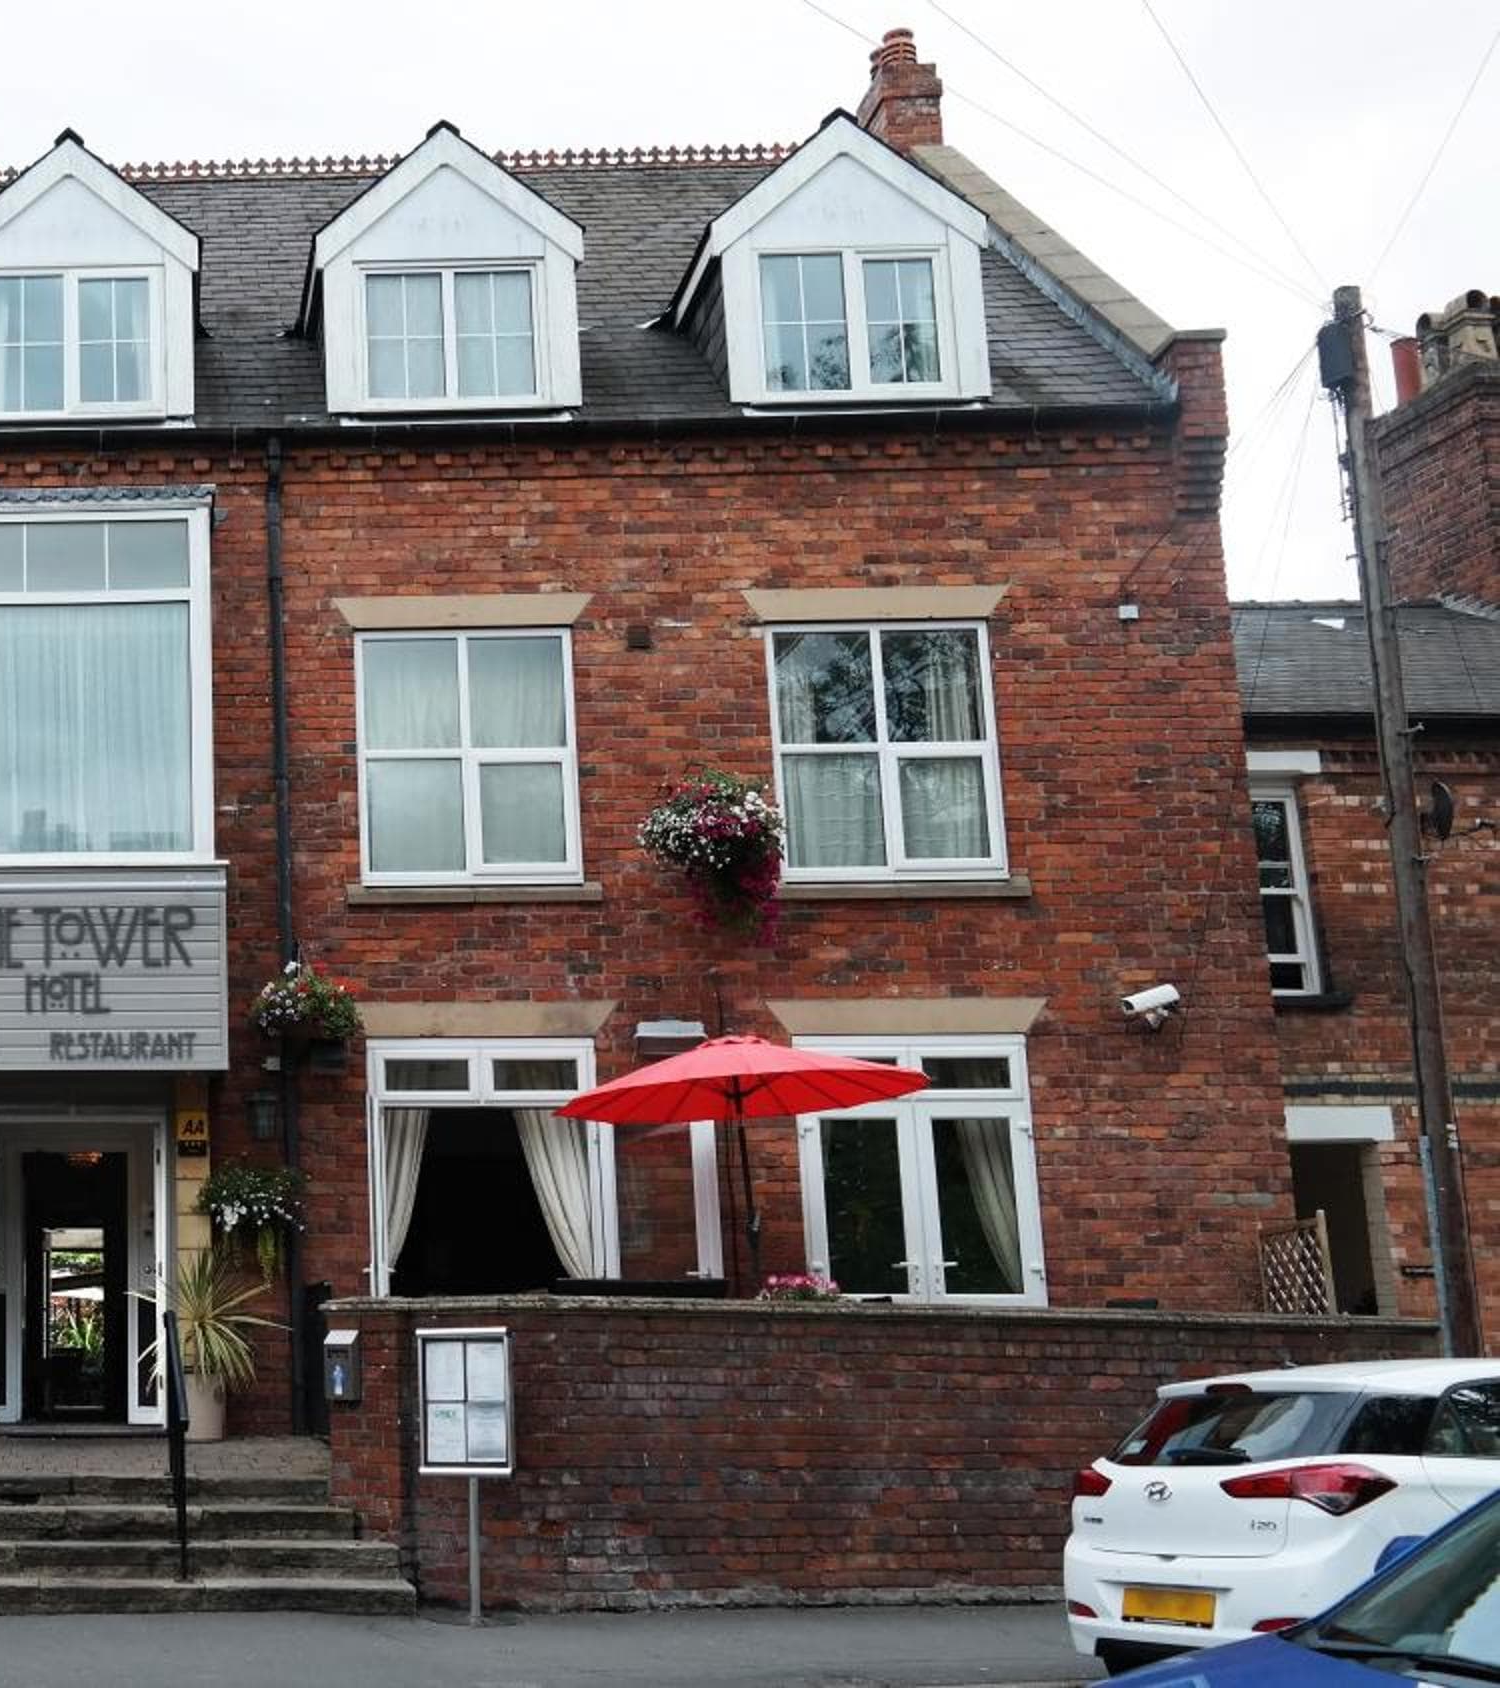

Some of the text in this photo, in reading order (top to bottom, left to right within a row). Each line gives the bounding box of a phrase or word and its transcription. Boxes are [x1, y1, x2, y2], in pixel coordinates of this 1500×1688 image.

[32, 905, 196, 969] TOWER
[25, 973, 111, 1014] HOTEL
[50, 1032, 196, 1060] RESTAURANT
[181, 1119, 205, 1135] AA
